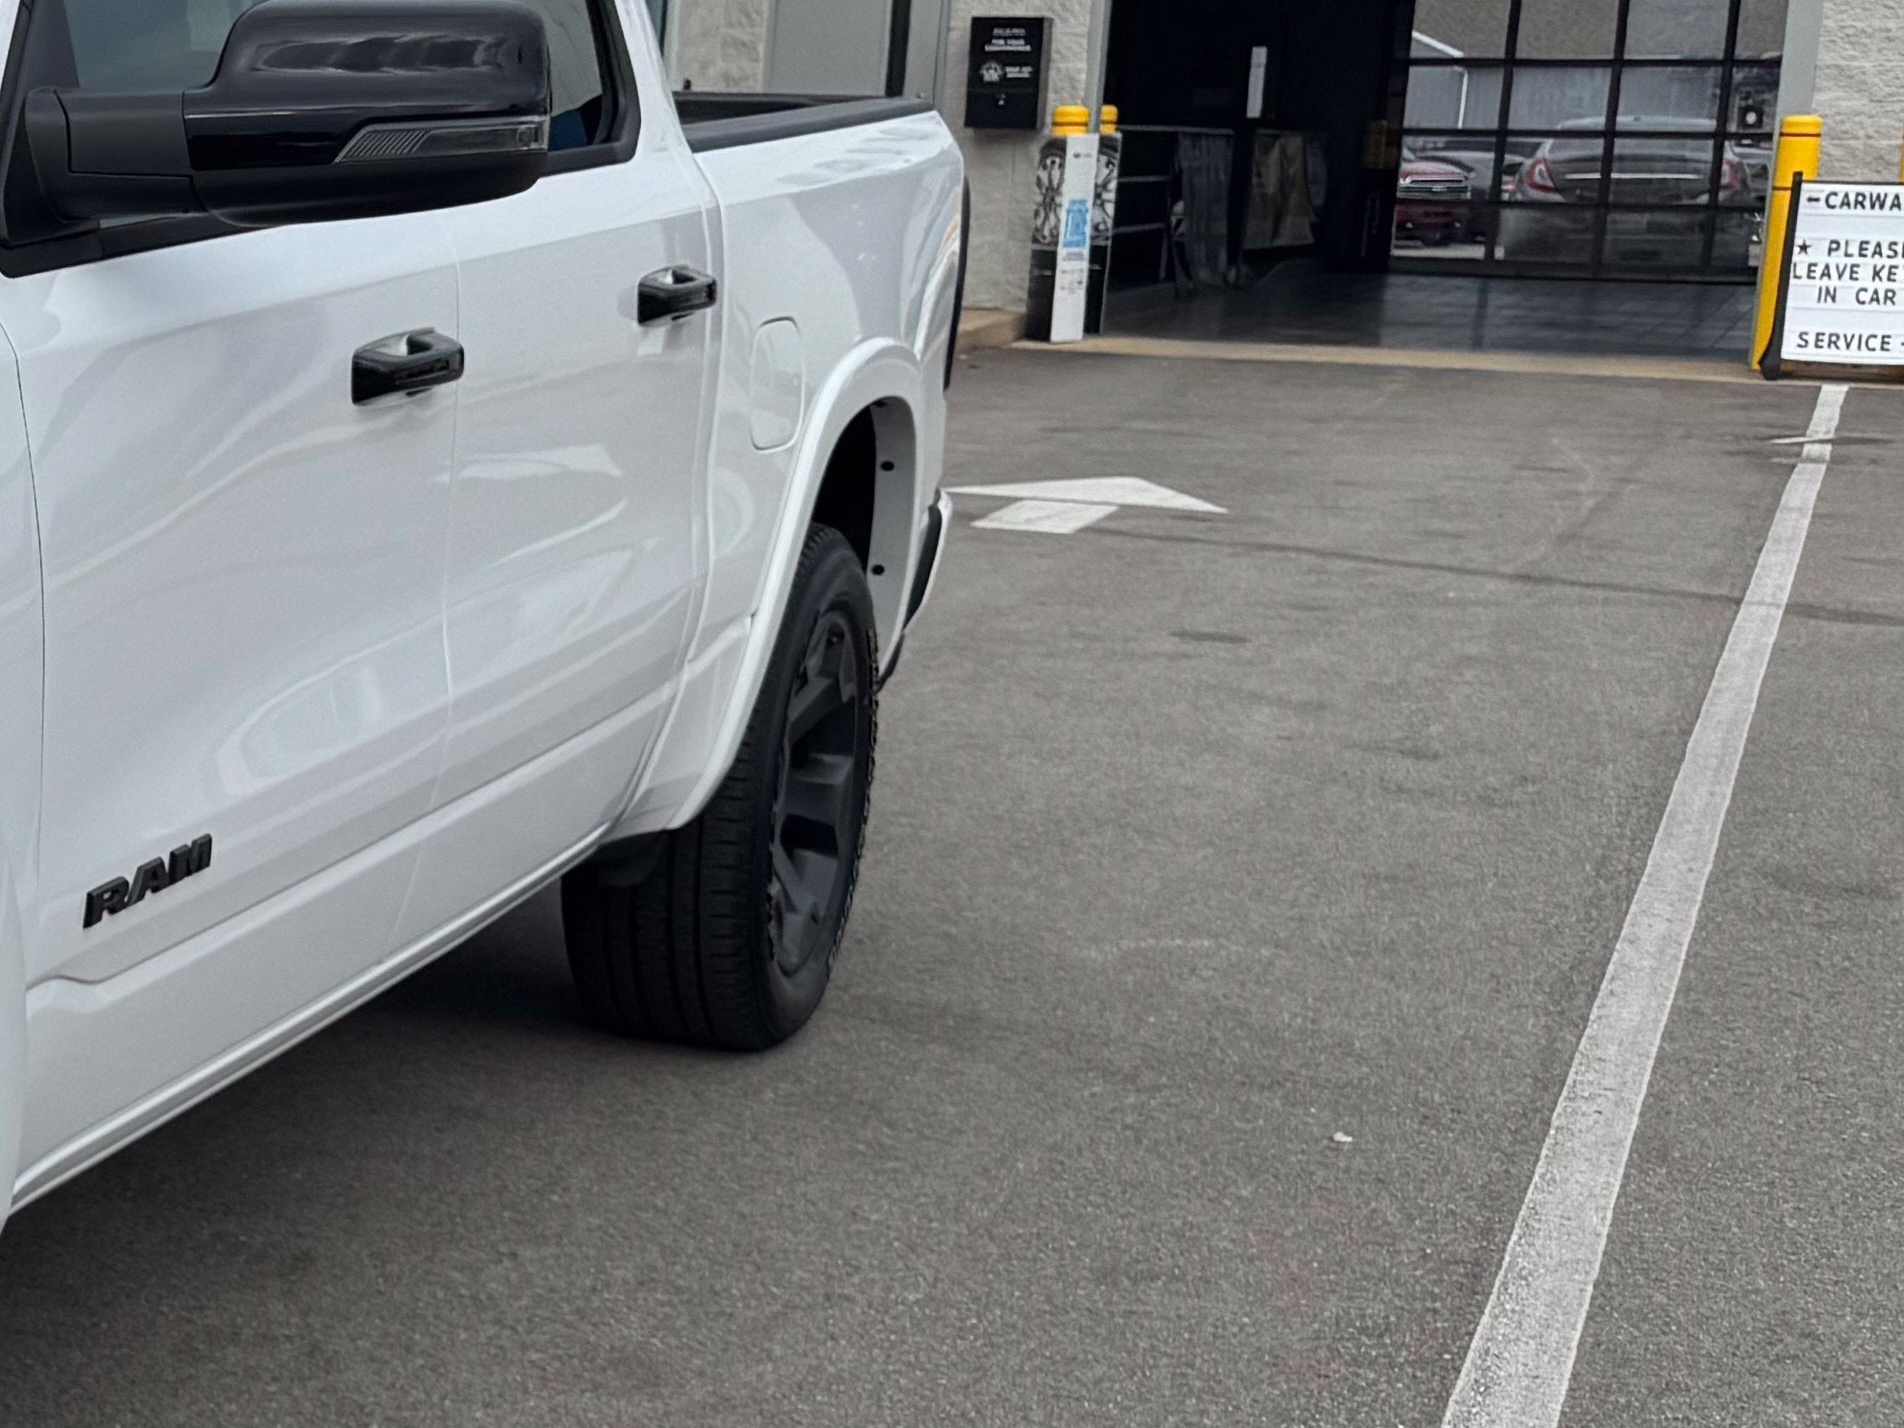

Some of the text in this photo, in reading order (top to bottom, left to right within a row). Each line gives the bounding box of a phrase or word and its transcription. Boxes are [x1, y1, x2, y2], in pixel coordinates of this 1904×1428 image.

[1827, 239, 1904, 260] PLEAS
[1793, 261, 1904, 283] LEAVE KE
[1817, 286, 1897, 306] IN CAR
[1796, 331, 1892, 352] SERVICE
[82, 832, 213, 930] RAM
